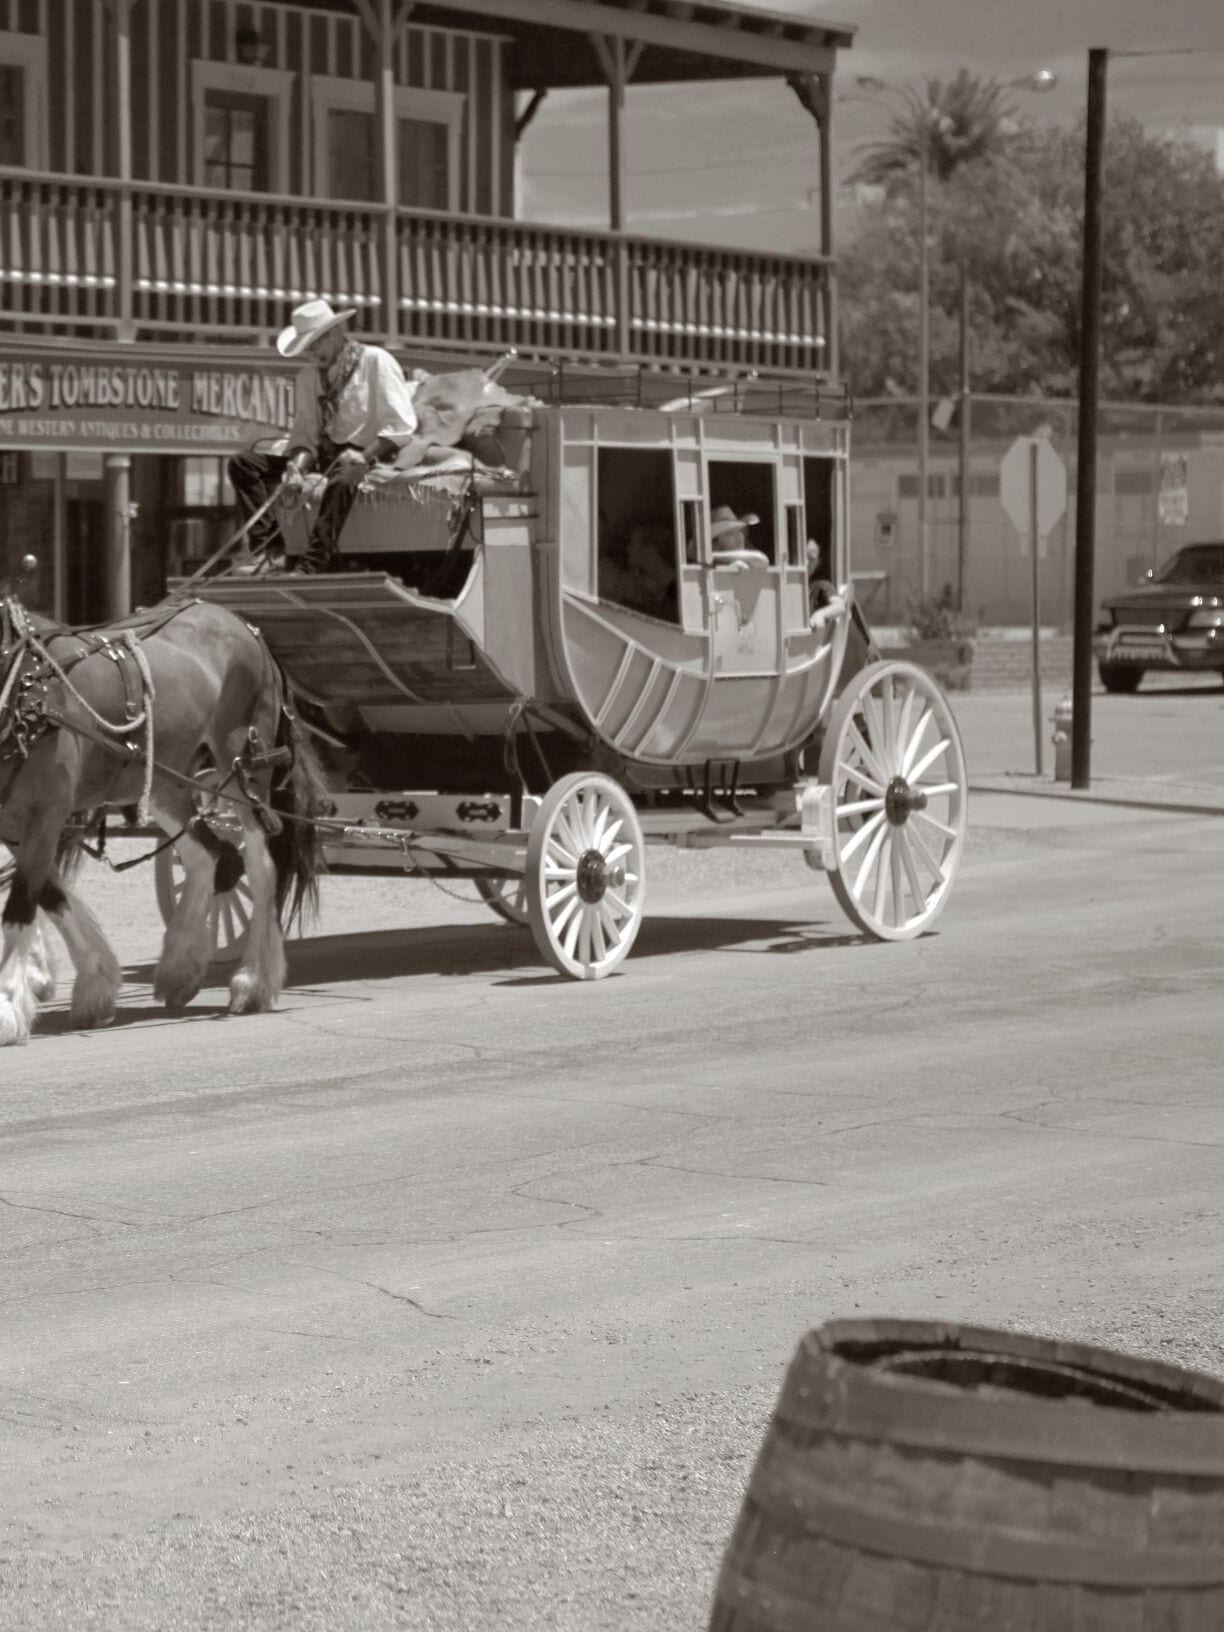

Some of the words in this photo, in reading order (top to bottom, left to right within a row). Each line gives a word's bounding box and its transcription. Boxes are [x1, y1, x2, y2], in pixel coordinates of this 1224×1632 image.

[49, 365, 180, 409] TOMBSTONE
[18, 419, 76, 437] WESTERN
[79, 420, 138, 440] ANTIQUES
[140, 423, 152, 439] &
[154, 423, 239, 442] COLLECTIBLES
